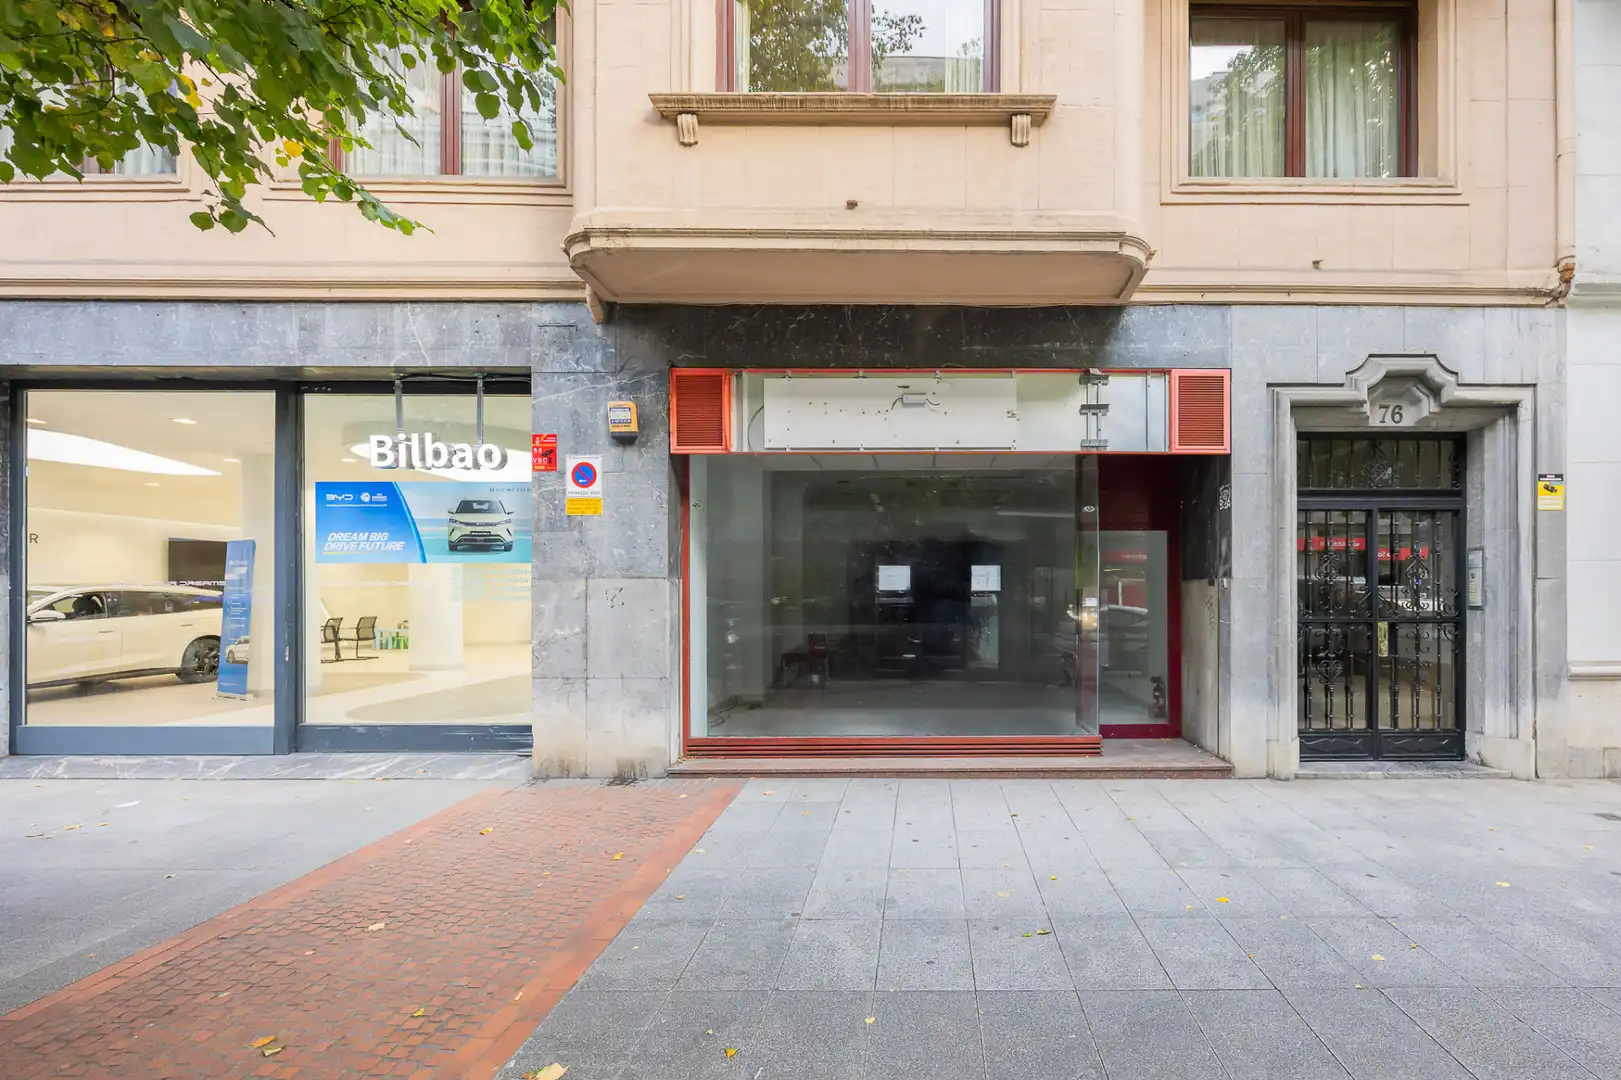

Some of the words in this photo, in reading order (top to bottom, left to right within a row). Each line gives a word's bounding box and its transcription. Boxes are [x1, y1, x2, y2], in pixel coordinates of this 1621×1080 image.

[1379, 404, 1403, 424] 76
[369, 433, 503, 471] Bilbao
[328, 532, 368, 541] DREAM
[369, 532, 389, 541] BIG
[324, 541, 357, 551] DRIVE
[359, 541, 405, 551] FUTURE
